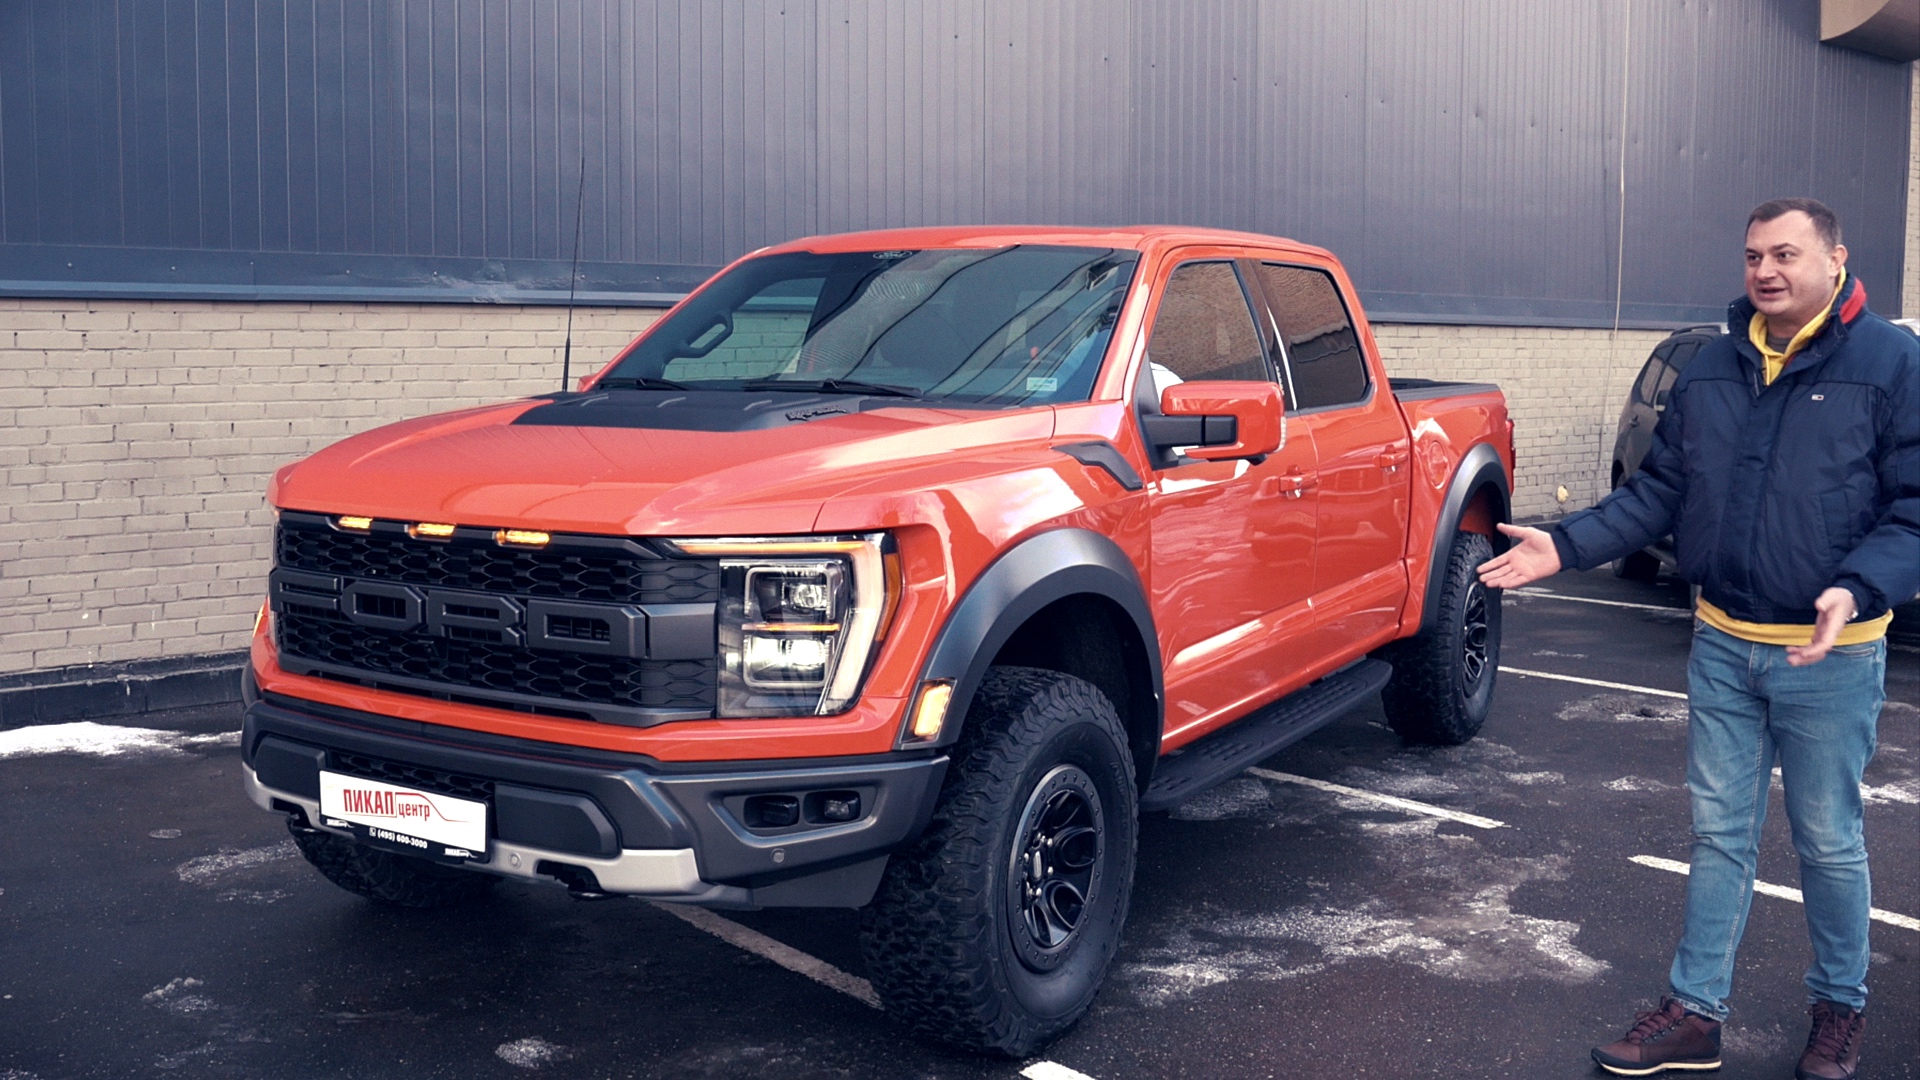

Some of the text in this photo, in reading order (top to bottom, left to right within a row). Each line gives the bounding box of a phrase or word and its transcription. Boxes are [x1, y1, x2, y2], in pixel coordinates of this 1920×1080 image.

[269, 568, 646, 658] FORD
[343, 789, 430, 821] ПИКАП центр
[377, 829, 428, 849] (495) 600-3000
